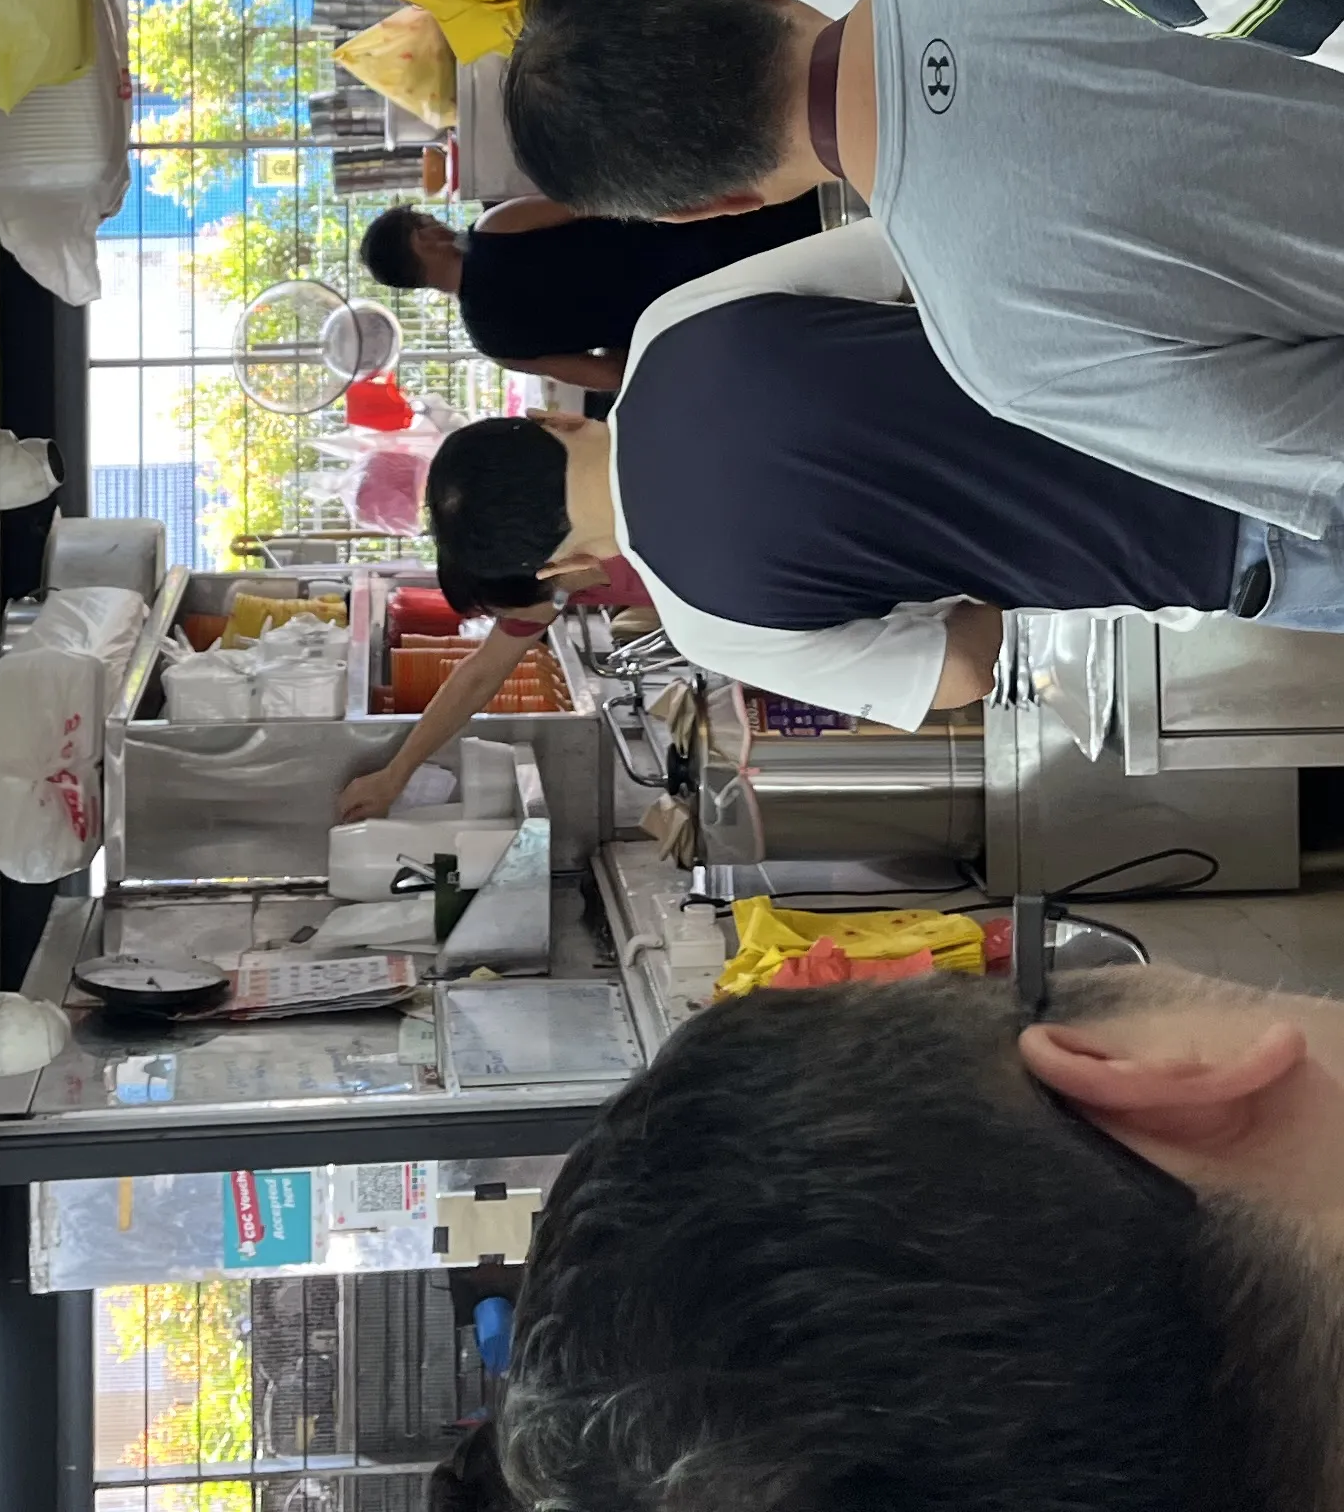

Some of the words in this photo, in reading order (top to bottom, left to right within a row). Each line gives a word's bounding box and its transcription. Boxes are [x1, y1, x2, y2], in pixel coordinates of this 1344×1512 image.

[281, 1178, 296, 1208] here
[264, 1178, 285, 1240] Accepted
[241, 1213, 257, 1239] CDC
